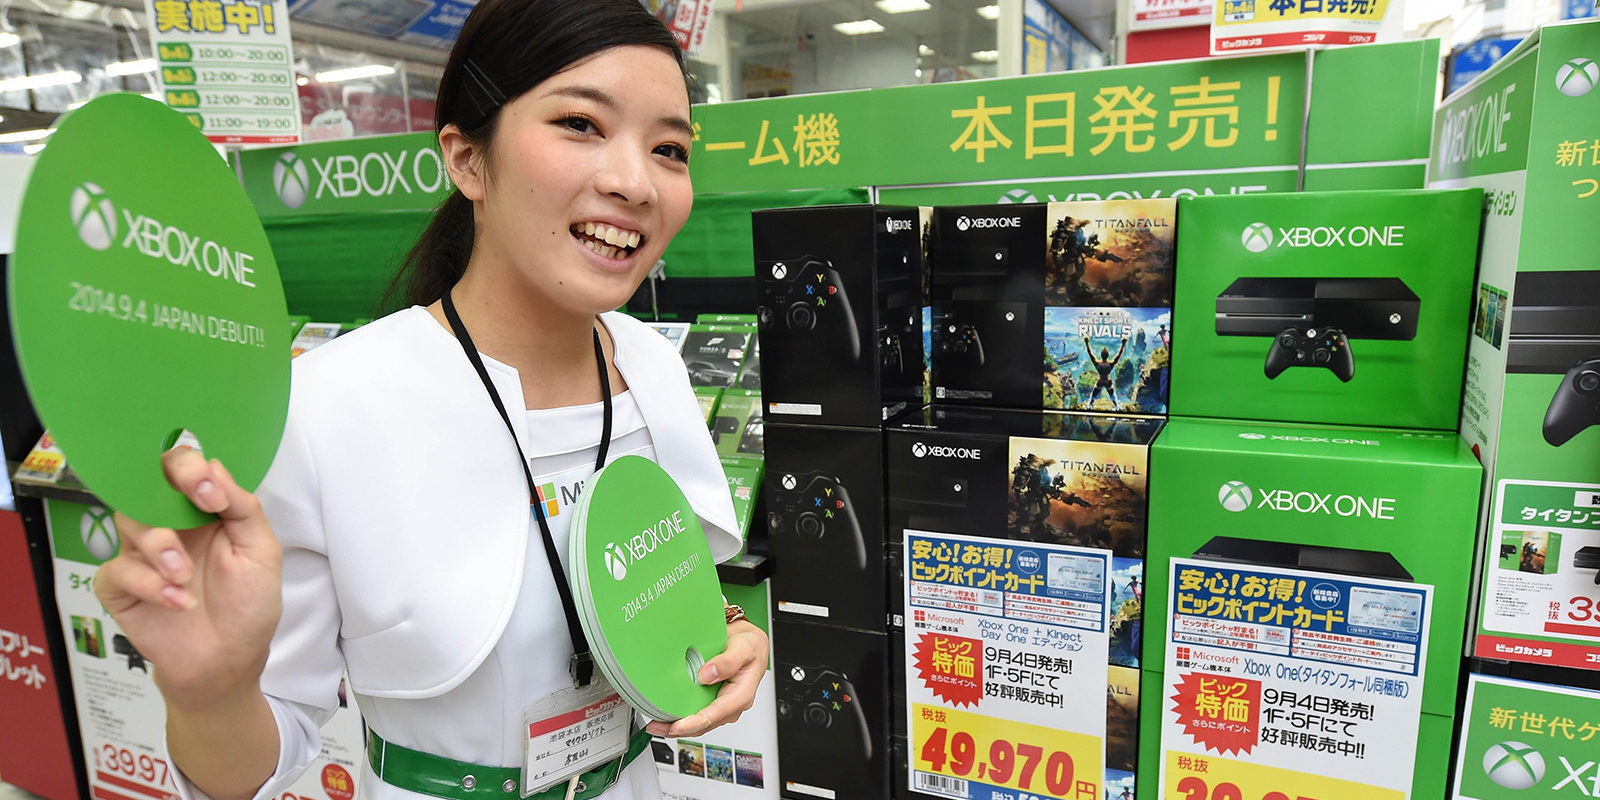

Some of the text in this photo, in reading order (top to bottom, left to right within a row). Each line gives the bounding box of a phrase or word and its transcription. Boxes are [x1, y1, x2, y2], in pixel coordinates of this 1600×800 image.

[950, 76, 1281, 163] 本日発売!
[1476, 83, 1516, 158] ONE
[312, 150, 412, 199] XBOX
[971, 217, 1021, 229] XBOX ONE
[1095, 217, 1168, 229] TITANFALL
[1277, 225, 1405, 248] XBOX ONE
[123, 209, 256, 288] XBOX ONE
[806, 285, 813, 295] X
[69, 281, 265, 348] 2014.9.4 JAPAN DEBUT!!
[1078, 325, 1132, 338] RIVALS
[1270, 434, 1380, 447] XBOX ONE
[928, 446, 981, 460] XBOX ONE
[1060, 460, 1139, 475] TITANFALL
[815, 498, 822, 507] X
[1257, 488, 1396, 520] XBOX ONE
[623, 510, 686, 565] XBOX ONE
[912, 540, 1014, 569] 安心!お得!
[621, 552, 702, 622] 2014.9.4 JAPAN DEBUT!!
[912, 561, 1045, 594] ビックポイントカード
[1178, 569, 1306, 604] 安心!お得!
[927, 612, 965, 626] Microsoft
[1177, 592, 1345, 632] ビックポイントカード
[1549, 601, 1560, 619] 税抜
[978, 619, 1003, 632] Xbox
[1008, 623, 1029, 635] One
[1047, 629, 1082, 643] Kinect
[981, 629, 1084, 652] Day One エディション
[934, 637, 972, 654] ビック
[1496, 643, 1553, 658] ビックカメラ
[931, 650, 976, 679] 特価
[985, 646, 1073, 675] 9月4日発売!
[1193, 651, 1240, 666] Microsoft
[1243, 658, 1271, 678] Xbox
[930, 673, 977, 689] さらにポイント
[1199, 677, 1248, 698] ビック
[985, 681, 1064, 708] 好評販売中!
[1263, 688, 1375, 722] 9月4日発売!
[922, 707, 947, 723] 税抜
[1194, 694, 1250, 723] 特価
[1192, 719, 1251, 734] さらにポイント
[1261, 727, 1366, 760] 好評販売中!!
[1177, 755, 1208, 773] 税抜
